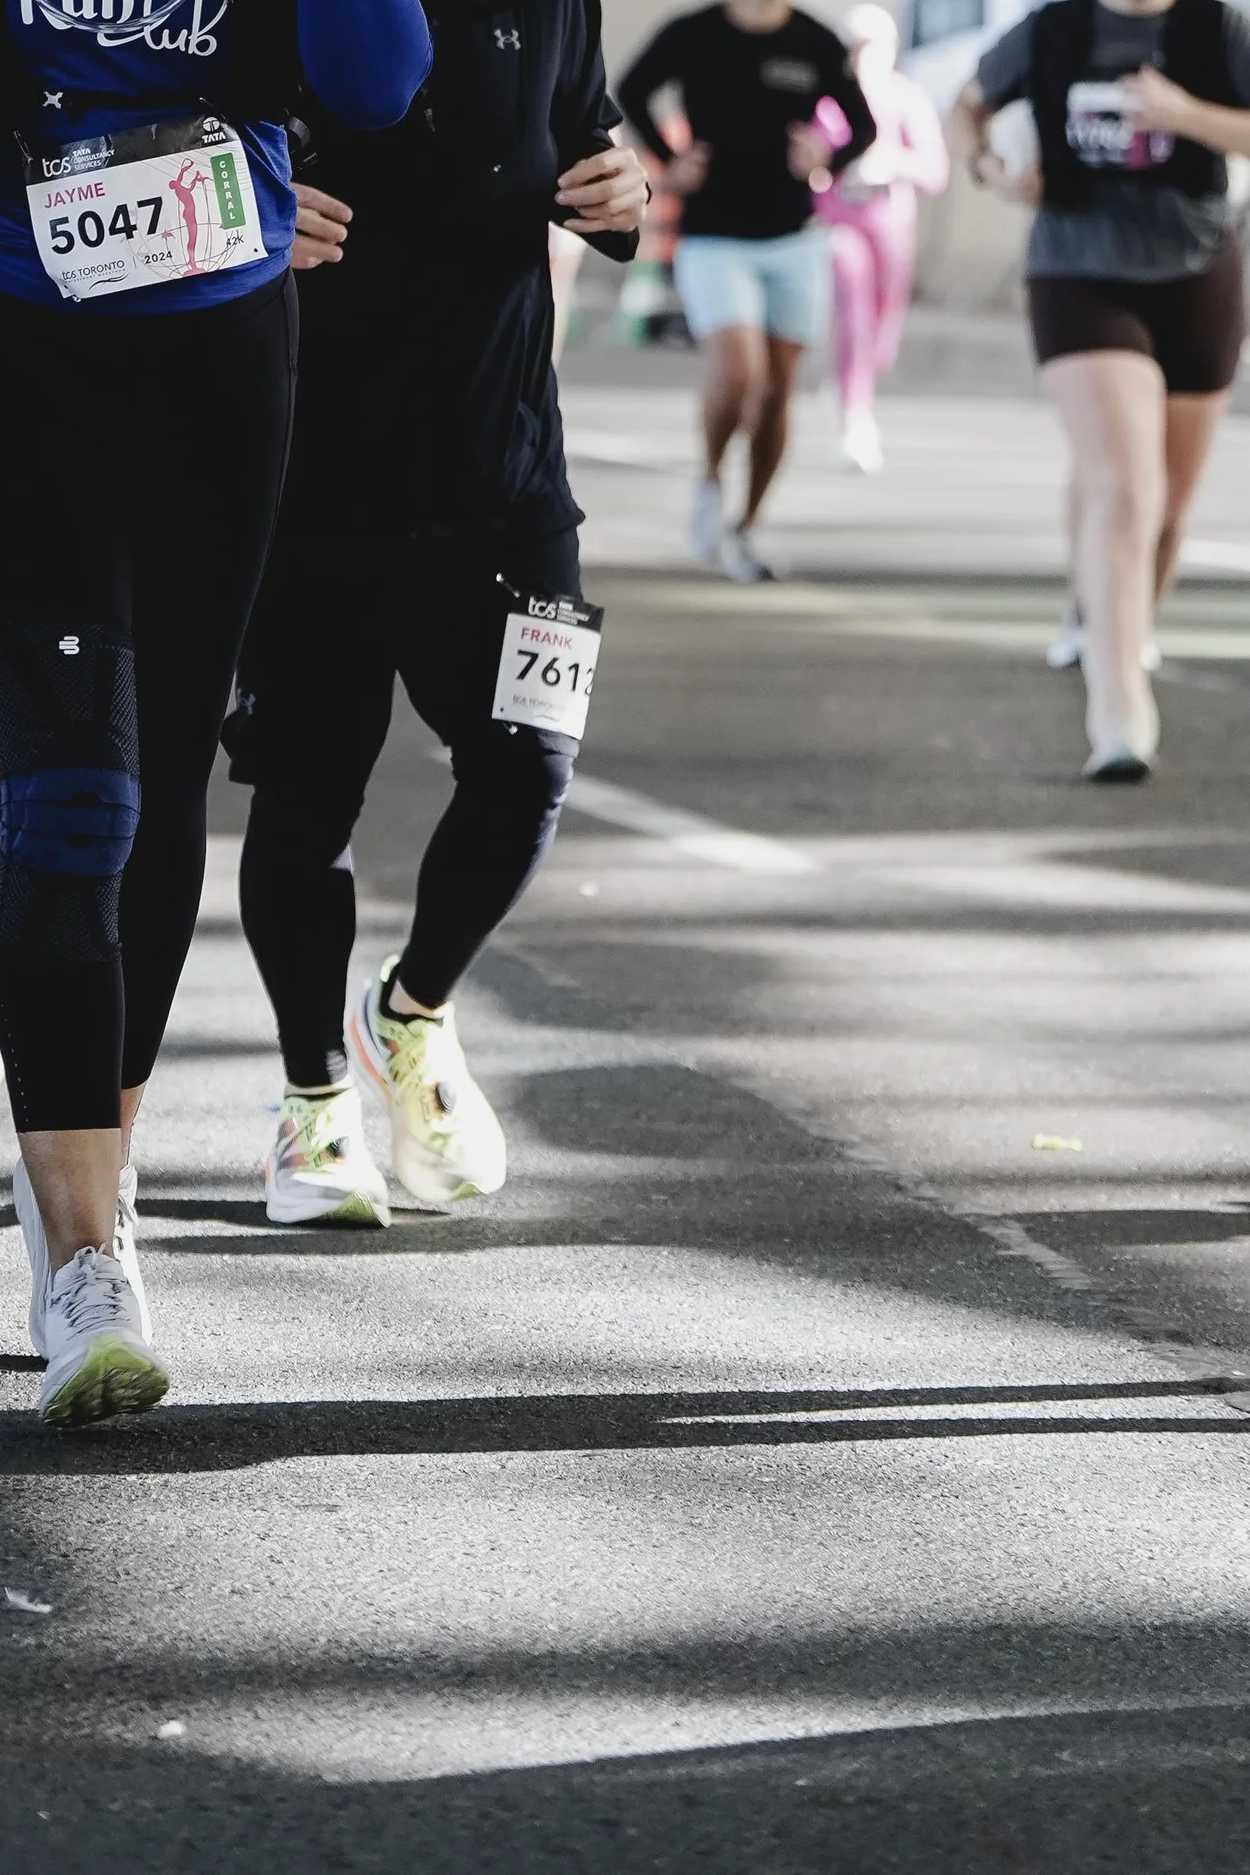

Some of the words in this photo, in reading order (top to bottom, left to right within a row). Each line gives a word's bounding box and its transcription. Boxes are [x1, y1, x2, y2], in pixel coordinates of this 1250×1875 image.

[202, 131, 226, 144] TATA
[42, 156, 71, 178] tcs
[72, 147, 91, 158] TATA
[73, 149, 115, 165] CONSULTANCY
[74, 159, 102, 171] SERVICES
[44, 182, 106, 209] JAYME
[219, 160, 237, 221] CORRAL
[50, 196, 164, 256] 5047
[225, 235, 245, 247] 42K
[62, 270, 76, 281] tcs
[78, 260, 125, 276] TORONTO
[144, 250, 173, 264] 2024
[528, 596, 558, 619] tcs
[520, 626, 573, 650] FRANK
